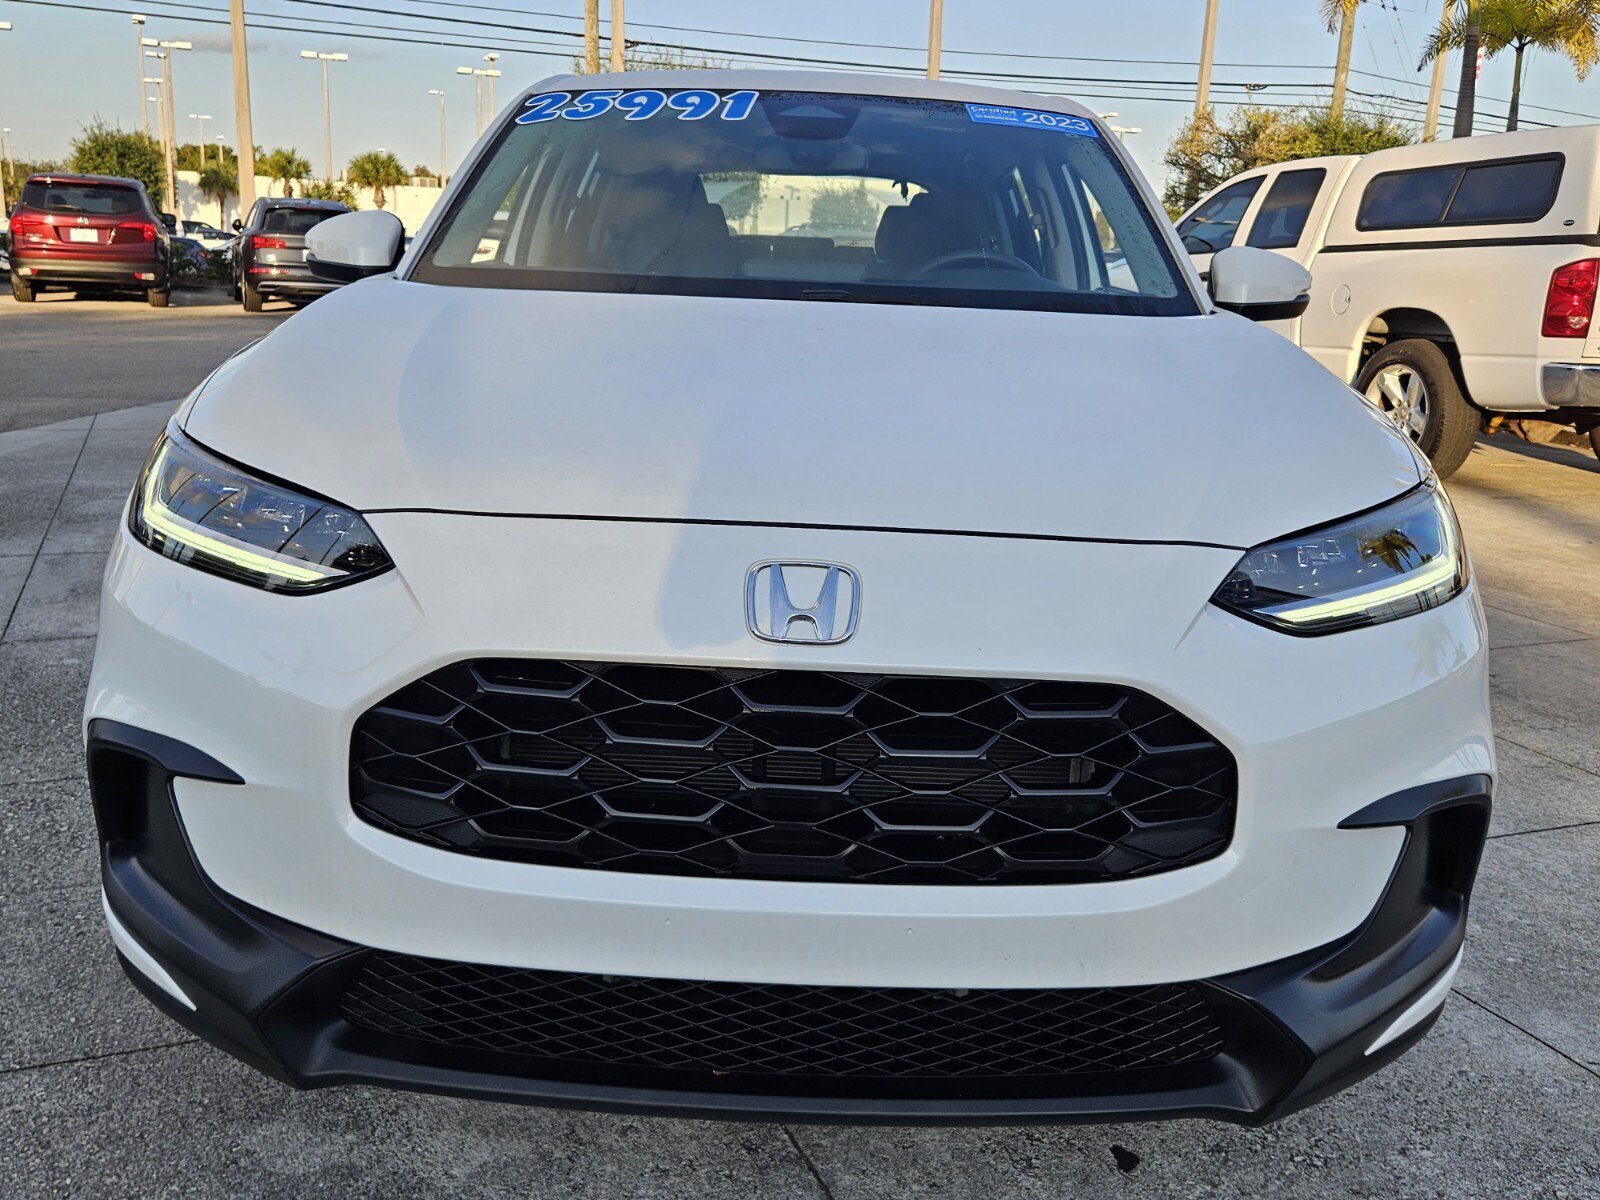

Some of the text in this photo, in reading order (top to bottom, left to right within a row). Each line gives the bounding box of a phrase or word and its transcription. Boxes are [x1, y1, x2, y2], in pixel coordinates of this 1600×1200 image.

[515, 90, 760, 125] 25991
[971, 106, 1016, 115] Certified
[1022, 112, 1090, 131] 2023
